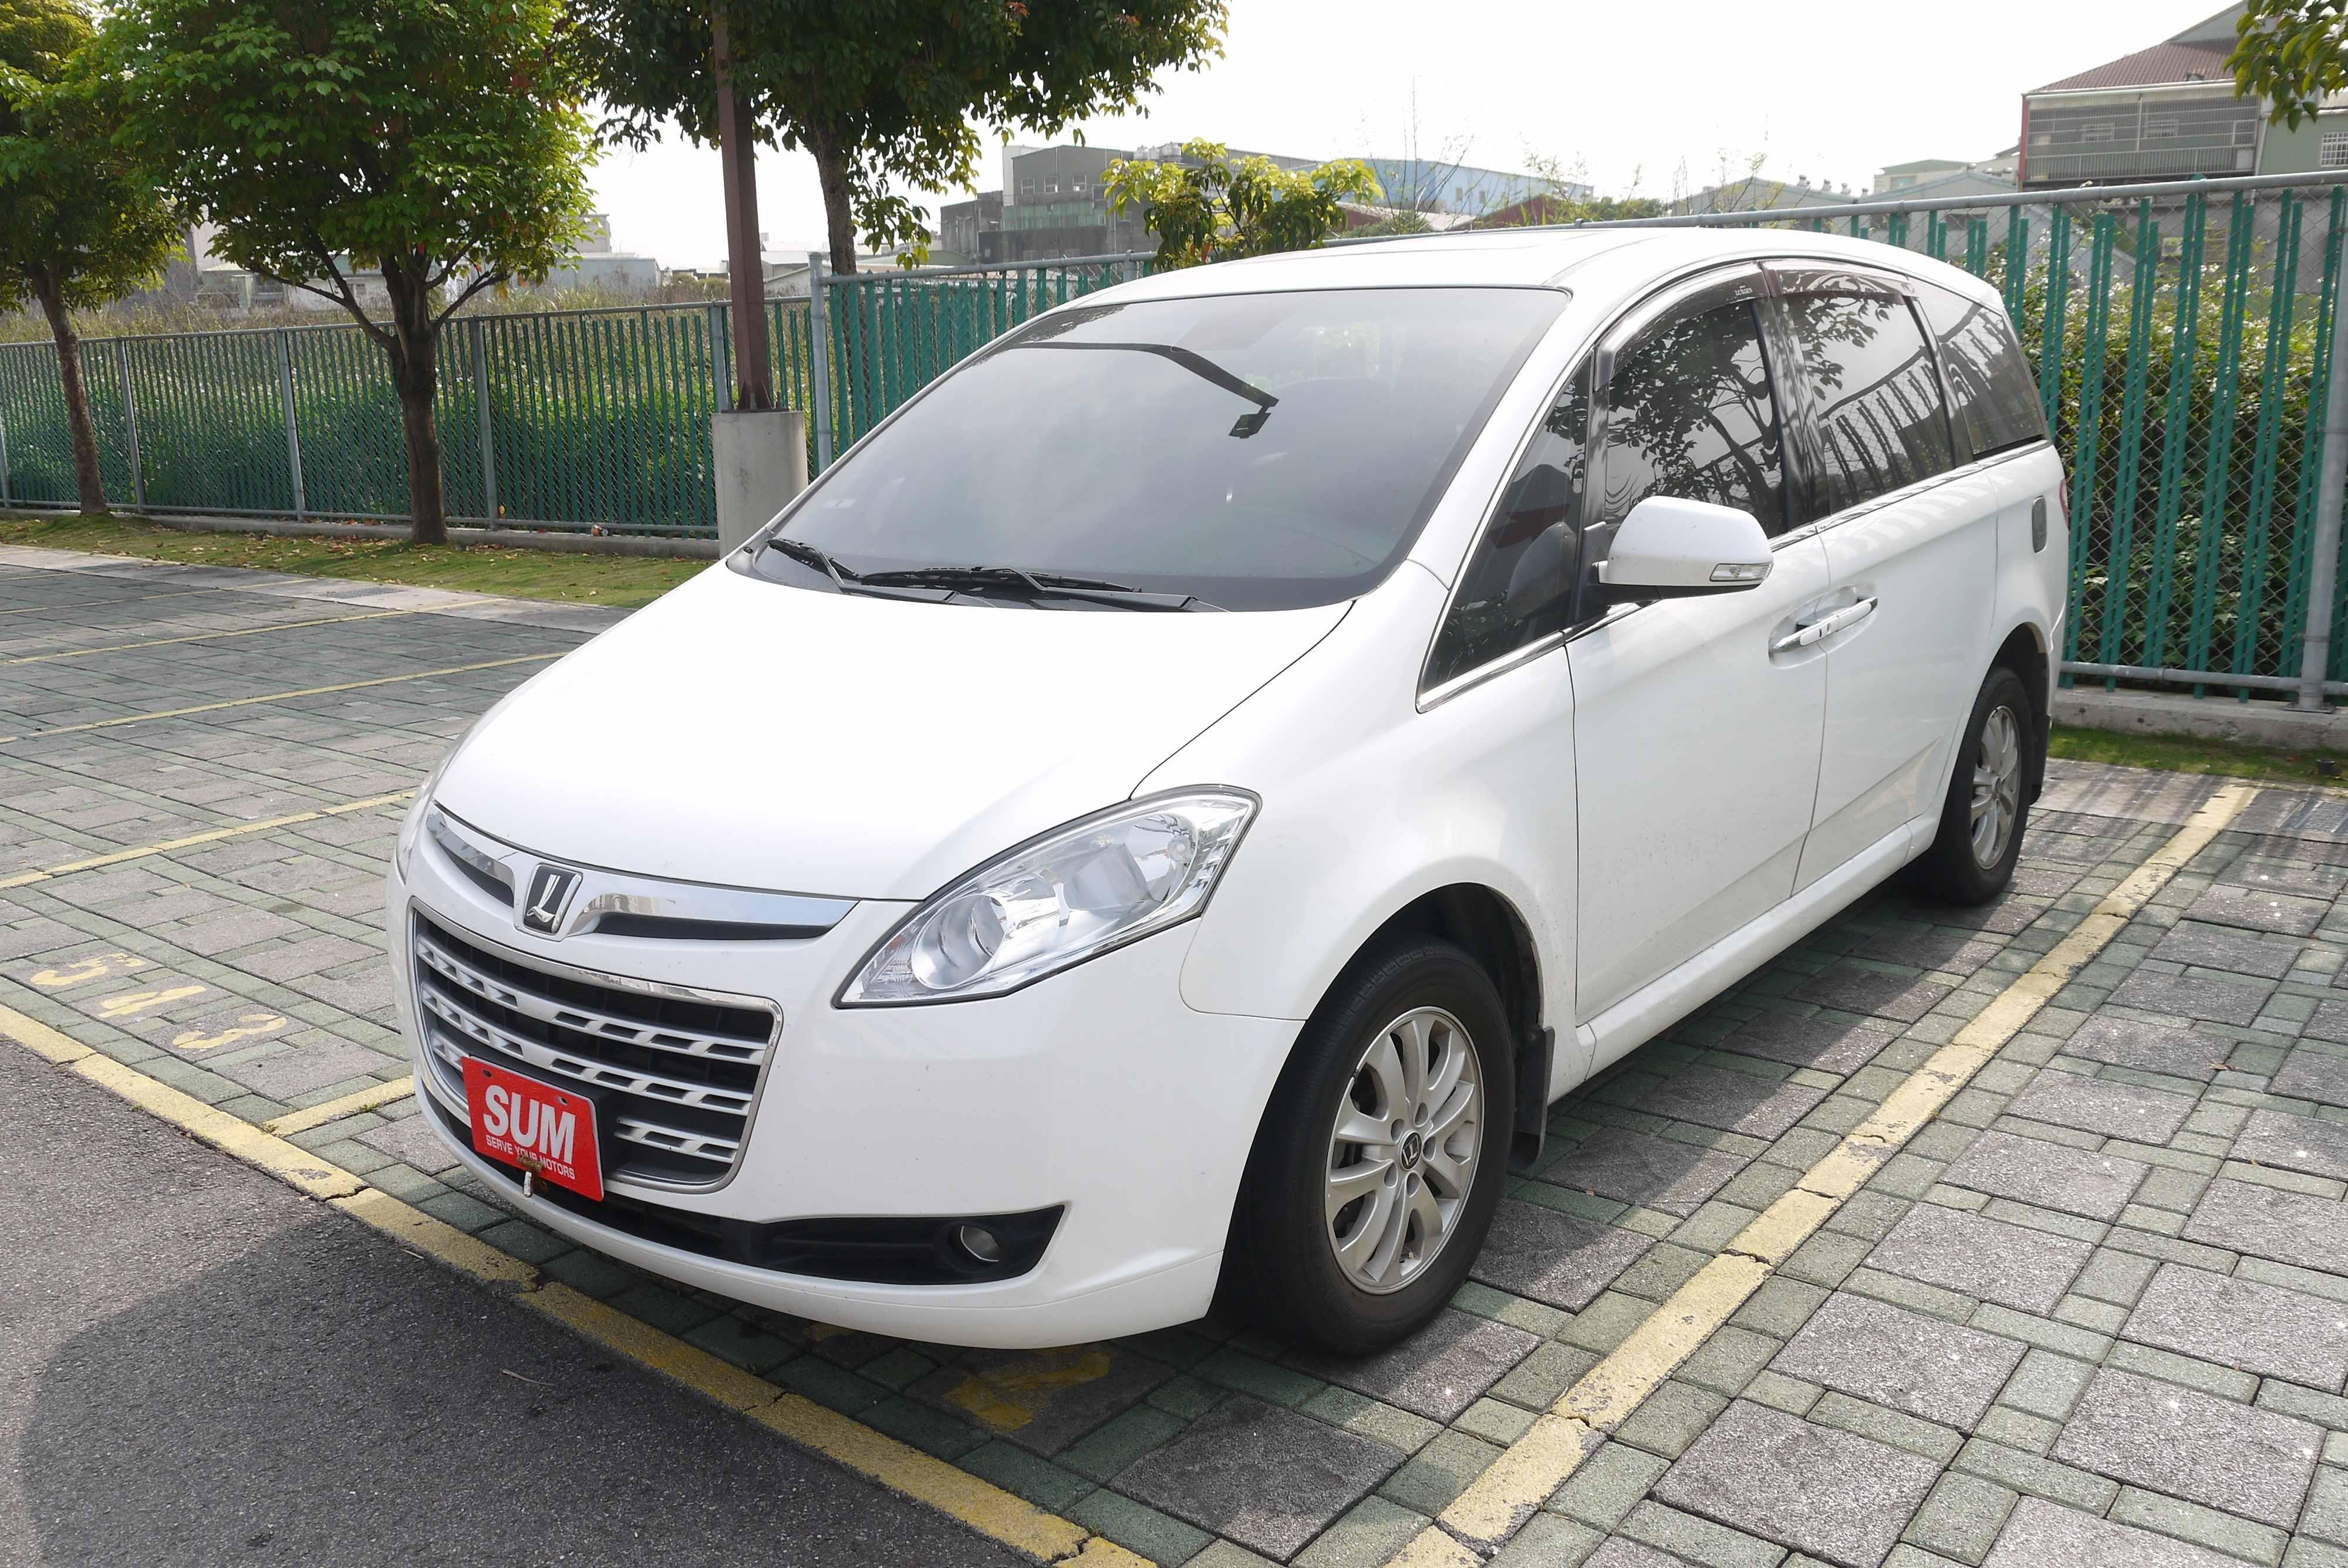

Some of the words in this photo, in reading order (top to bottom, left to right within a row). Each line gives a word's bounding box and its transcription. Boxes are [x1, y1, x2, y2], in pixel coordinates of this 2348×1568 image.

[484, 1085, 576, 1164] SUM
[486, 1134, 513, 1154] SERVE
[539, 1155, 575, 1180] MOTORS
